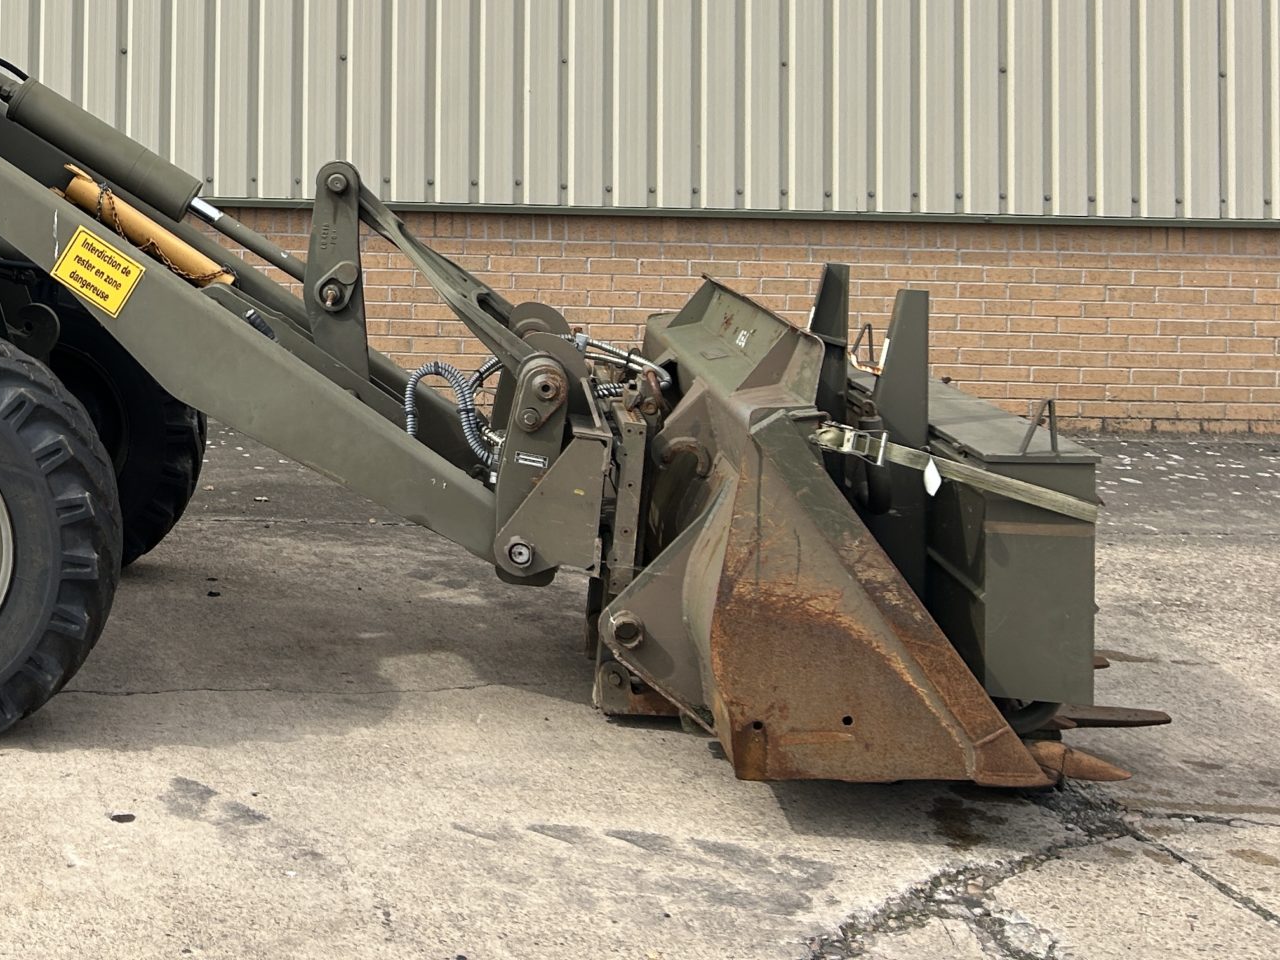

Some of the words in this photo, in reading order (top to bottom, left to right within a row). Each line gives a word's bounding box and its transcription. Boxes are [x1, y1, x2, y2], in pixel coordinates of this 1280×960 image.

[73, 254, 96, 273] rester
[95, 269, 105, 279] en
[104, 275, 122, 290] zone
[81, 238, 121, 271] Interdiction
[121, 266, 131, 277] de
[69, 270, 110, 302] dangereuse
